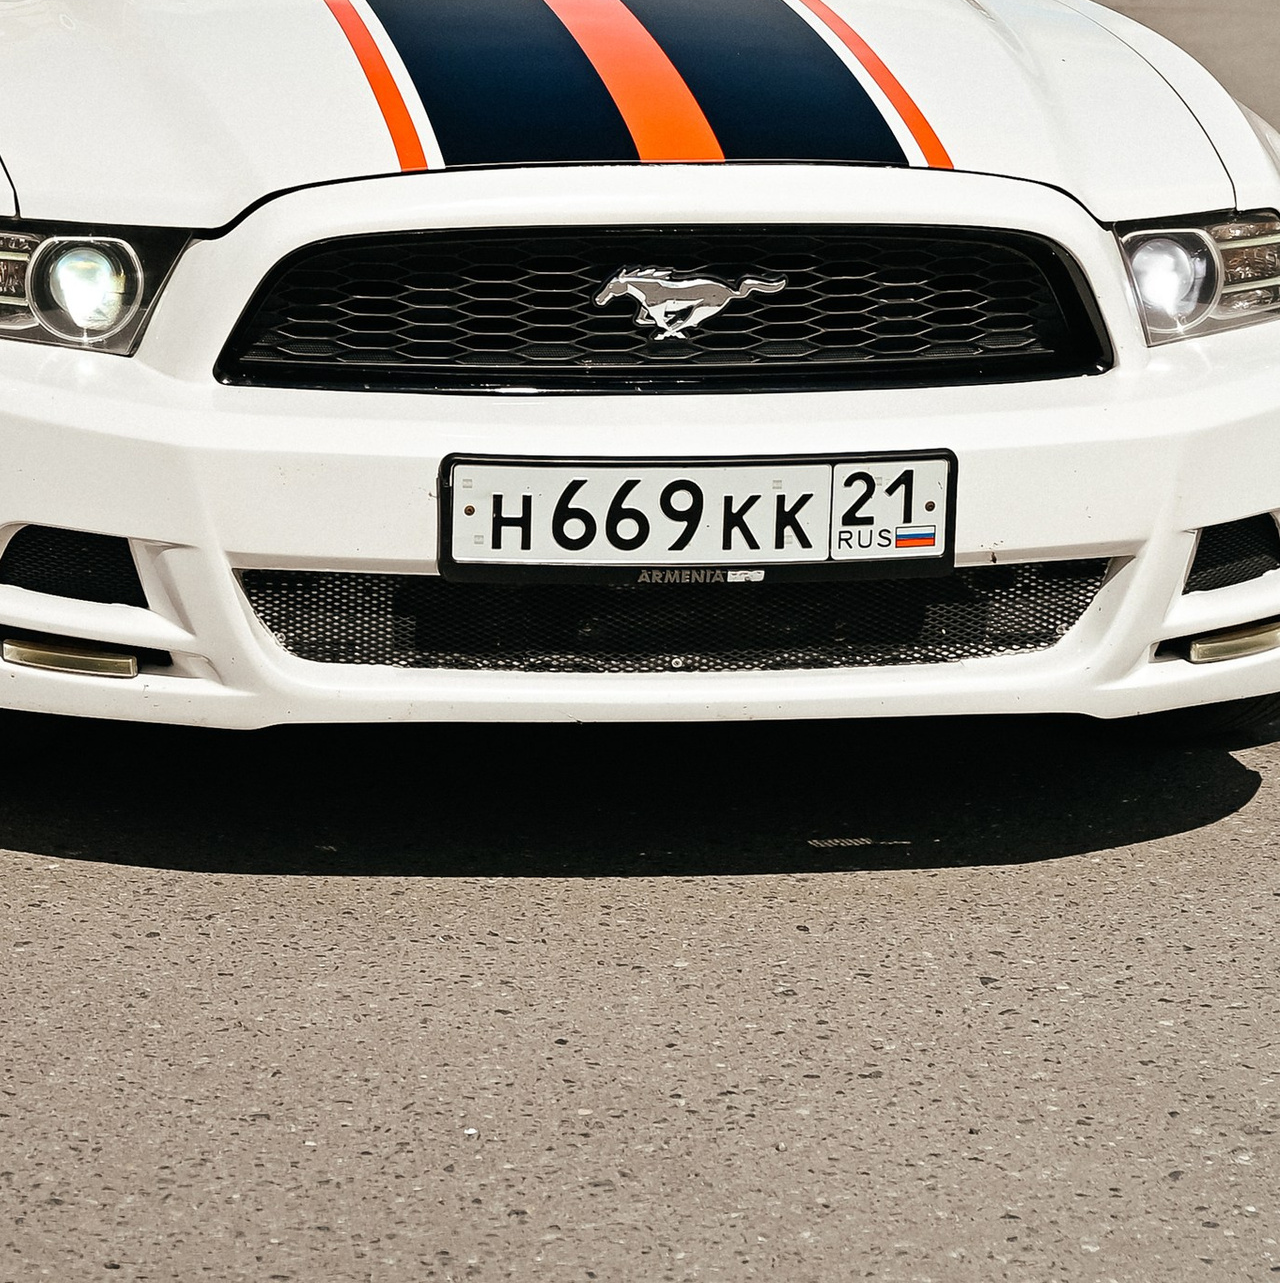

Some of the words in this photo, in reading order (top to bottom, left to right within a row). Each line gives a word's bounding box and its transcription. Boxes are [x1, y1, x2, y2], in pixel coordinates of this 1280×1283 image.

[840, 469, 915, 526] 21
[837, 529, 892, 550] RUS
[637, 569, 726, 583] ARMENIA
